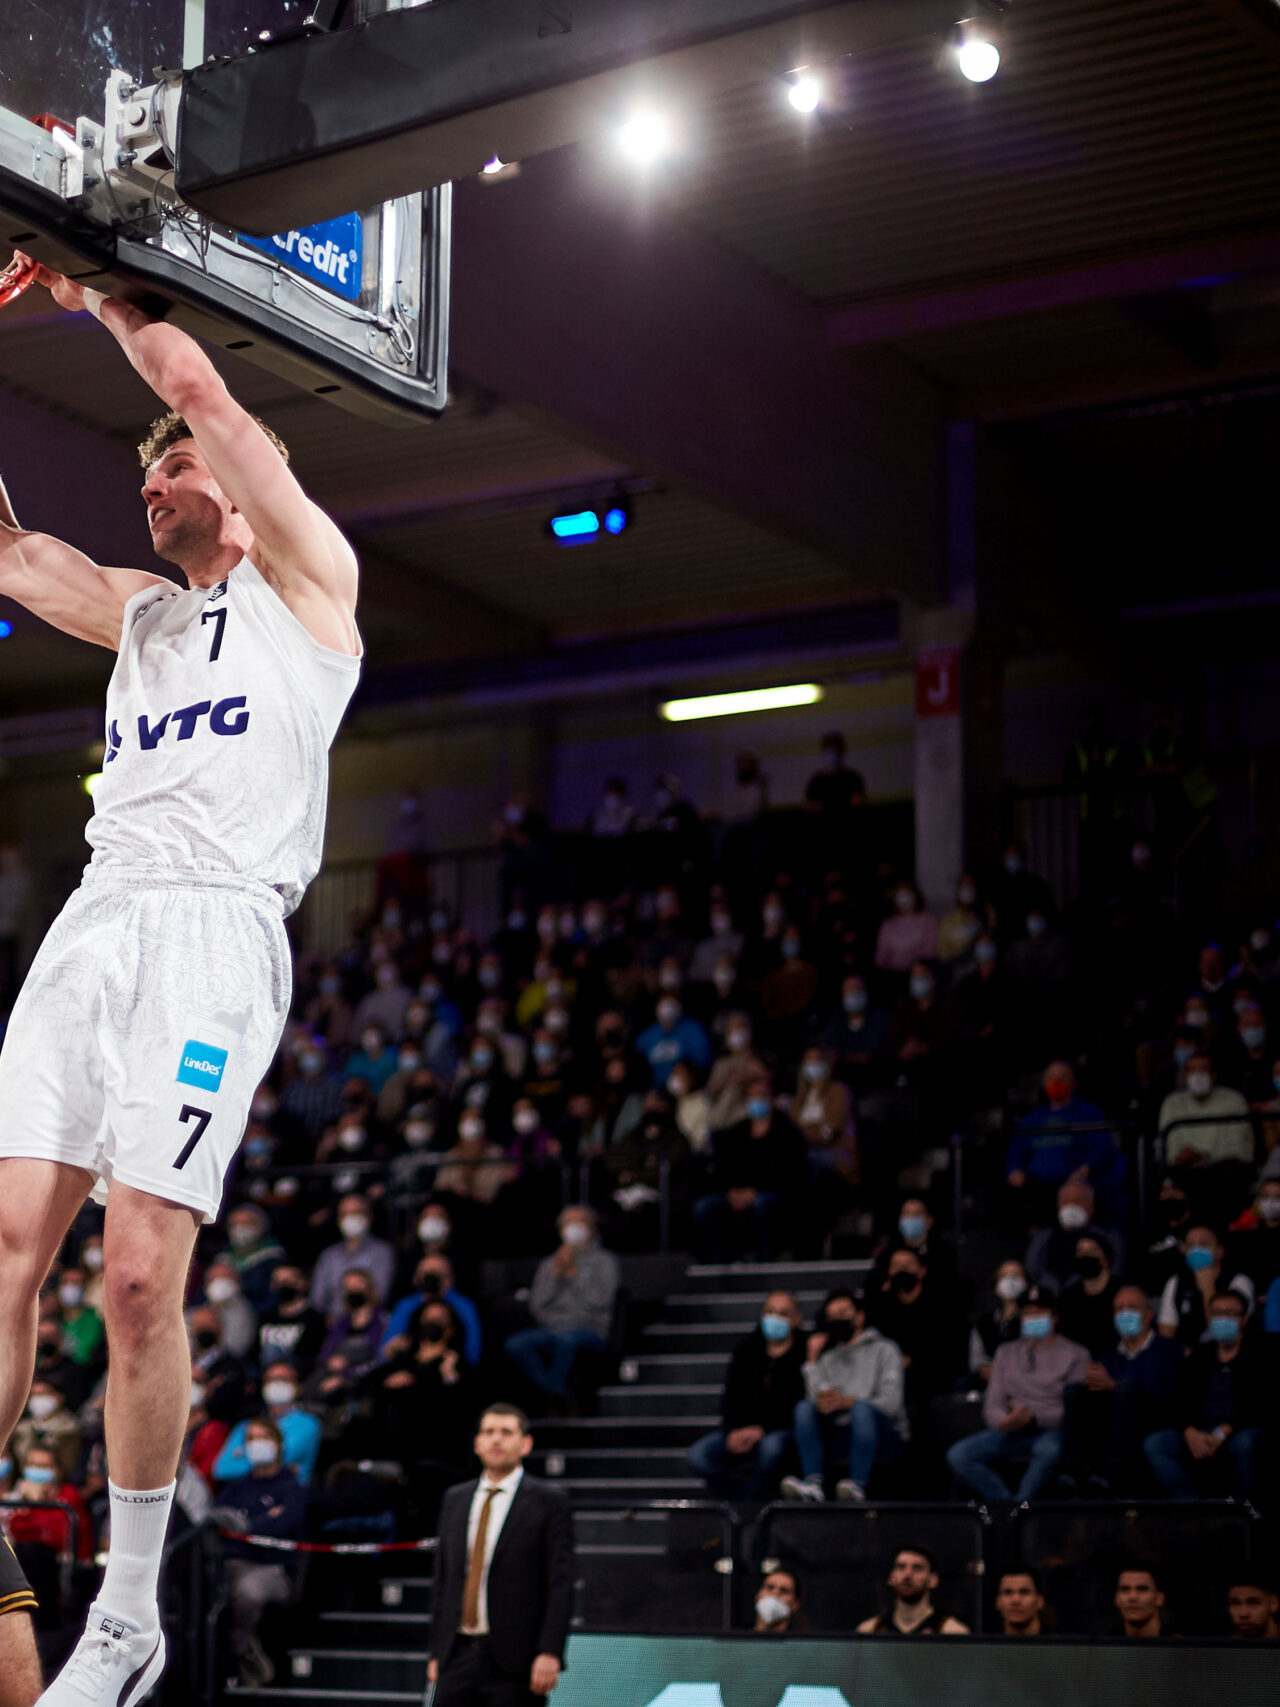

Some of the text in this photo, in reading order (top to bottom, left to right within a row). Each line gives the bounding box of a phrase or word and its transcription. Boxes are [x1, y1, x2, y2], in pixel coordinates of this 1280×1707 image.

[201, 607, 227, 662] 7
[137, 695, 250, 750] VTG
[172, 1104, 212, 1170] 7
